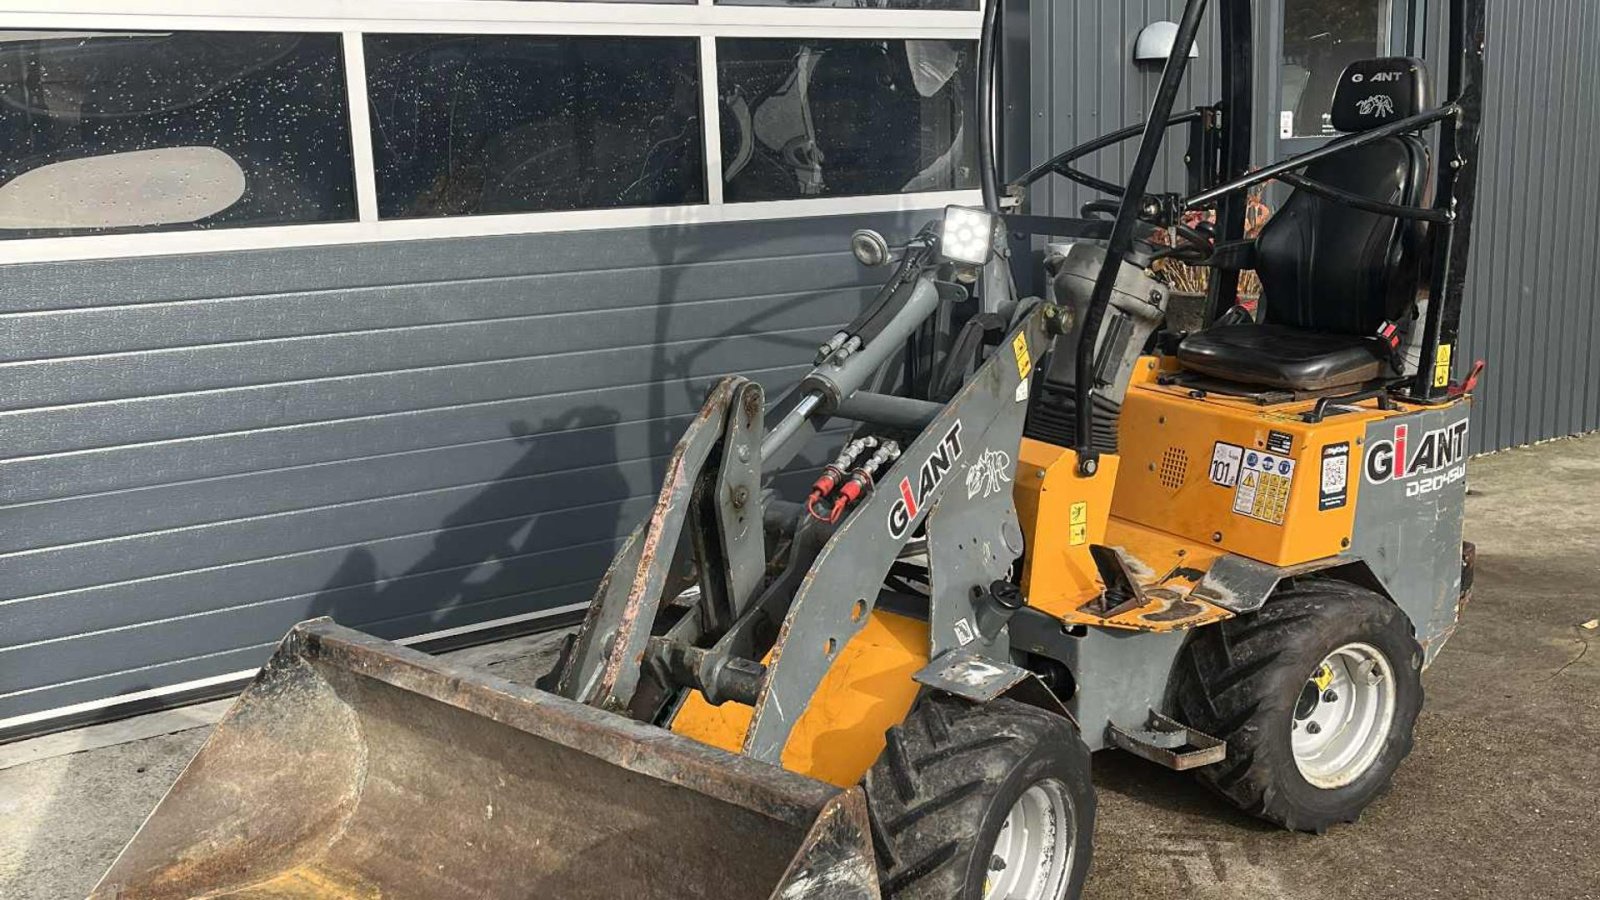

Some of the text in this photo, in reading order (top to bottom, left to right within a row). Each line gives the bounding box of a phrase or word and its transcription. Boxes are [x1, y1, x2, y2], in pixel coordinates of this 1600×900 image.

[1351, 72, 1402, 82] GANT
[1212, 460, 1230, 483] 101
[1406, 462, 1466, 497] D204SW
